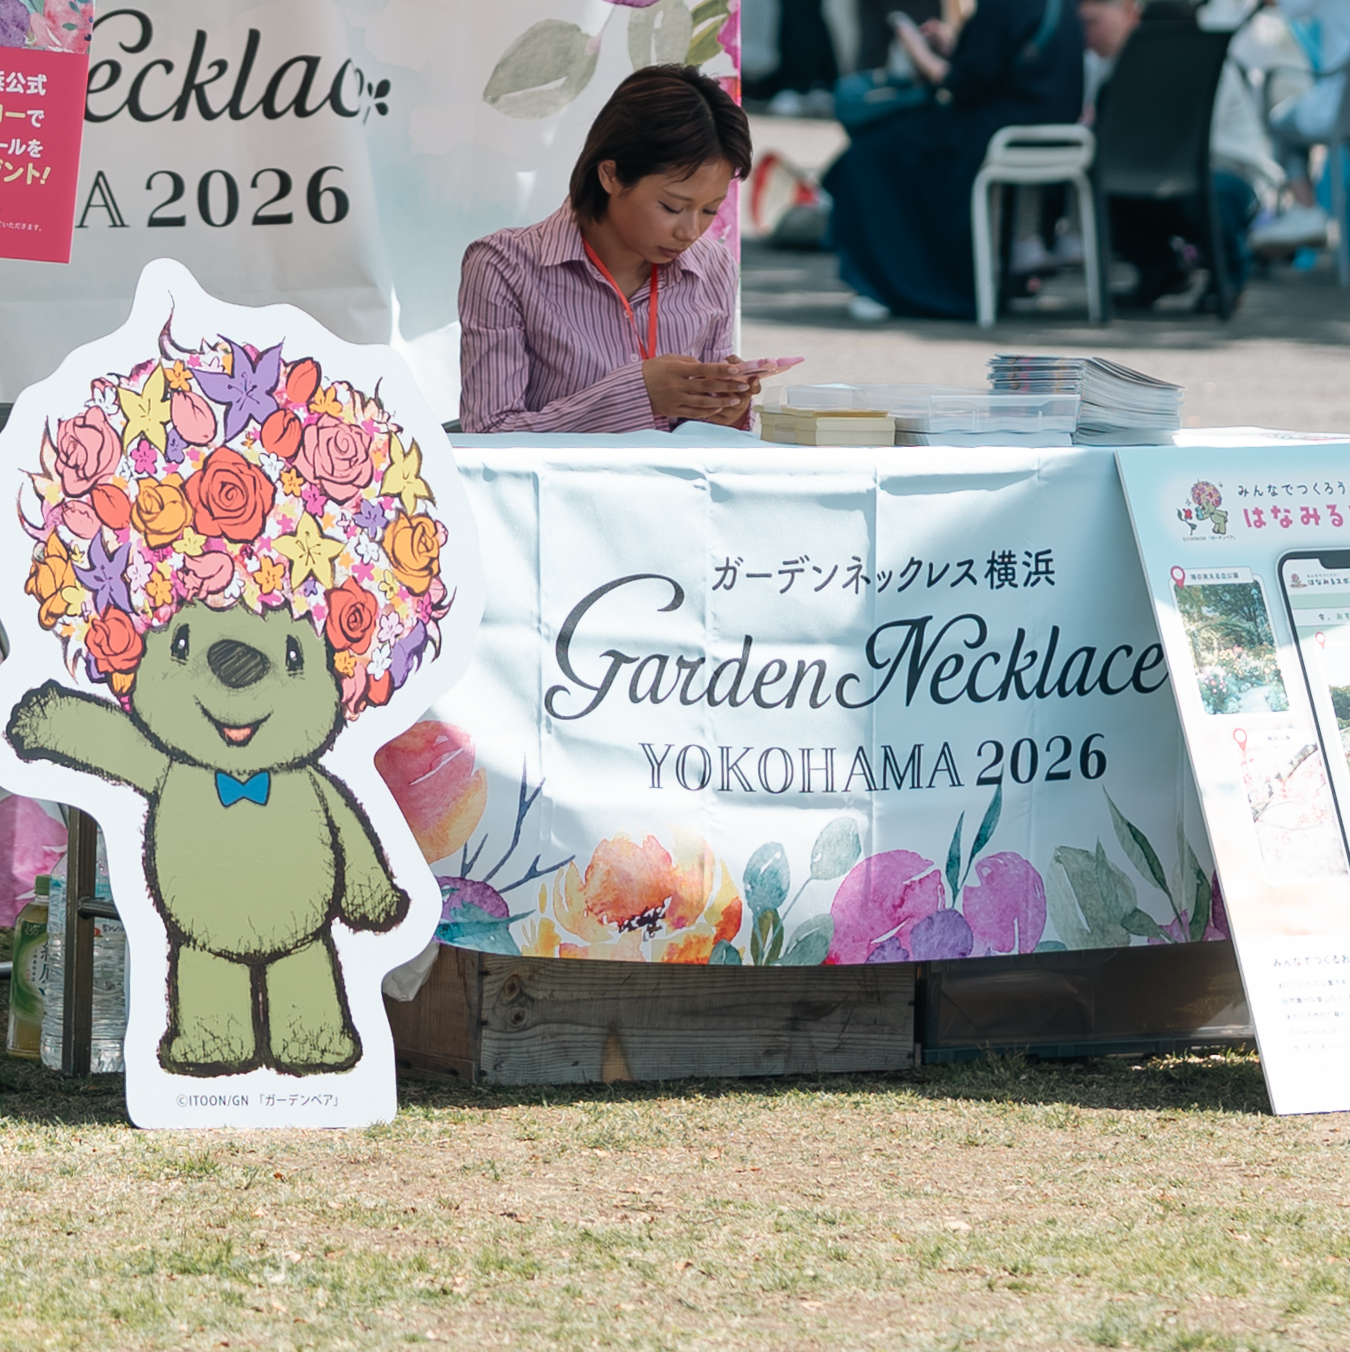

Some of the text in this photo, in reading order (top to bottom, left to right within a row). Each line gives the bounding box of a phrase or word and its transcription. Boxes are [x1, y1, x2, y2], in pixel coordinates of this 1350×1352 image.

[145, 165, 350, 228] 2026
[710, 548, 1057, 596] ガーデンネックレス横浜
[545, 573, 1171, 721] Garden Necklace
[638, 732, 1109, 795] YOKOHAMA 2026
[176, 1093, 339, 1108] ©ITOON/GN 「ガーデンベア」
